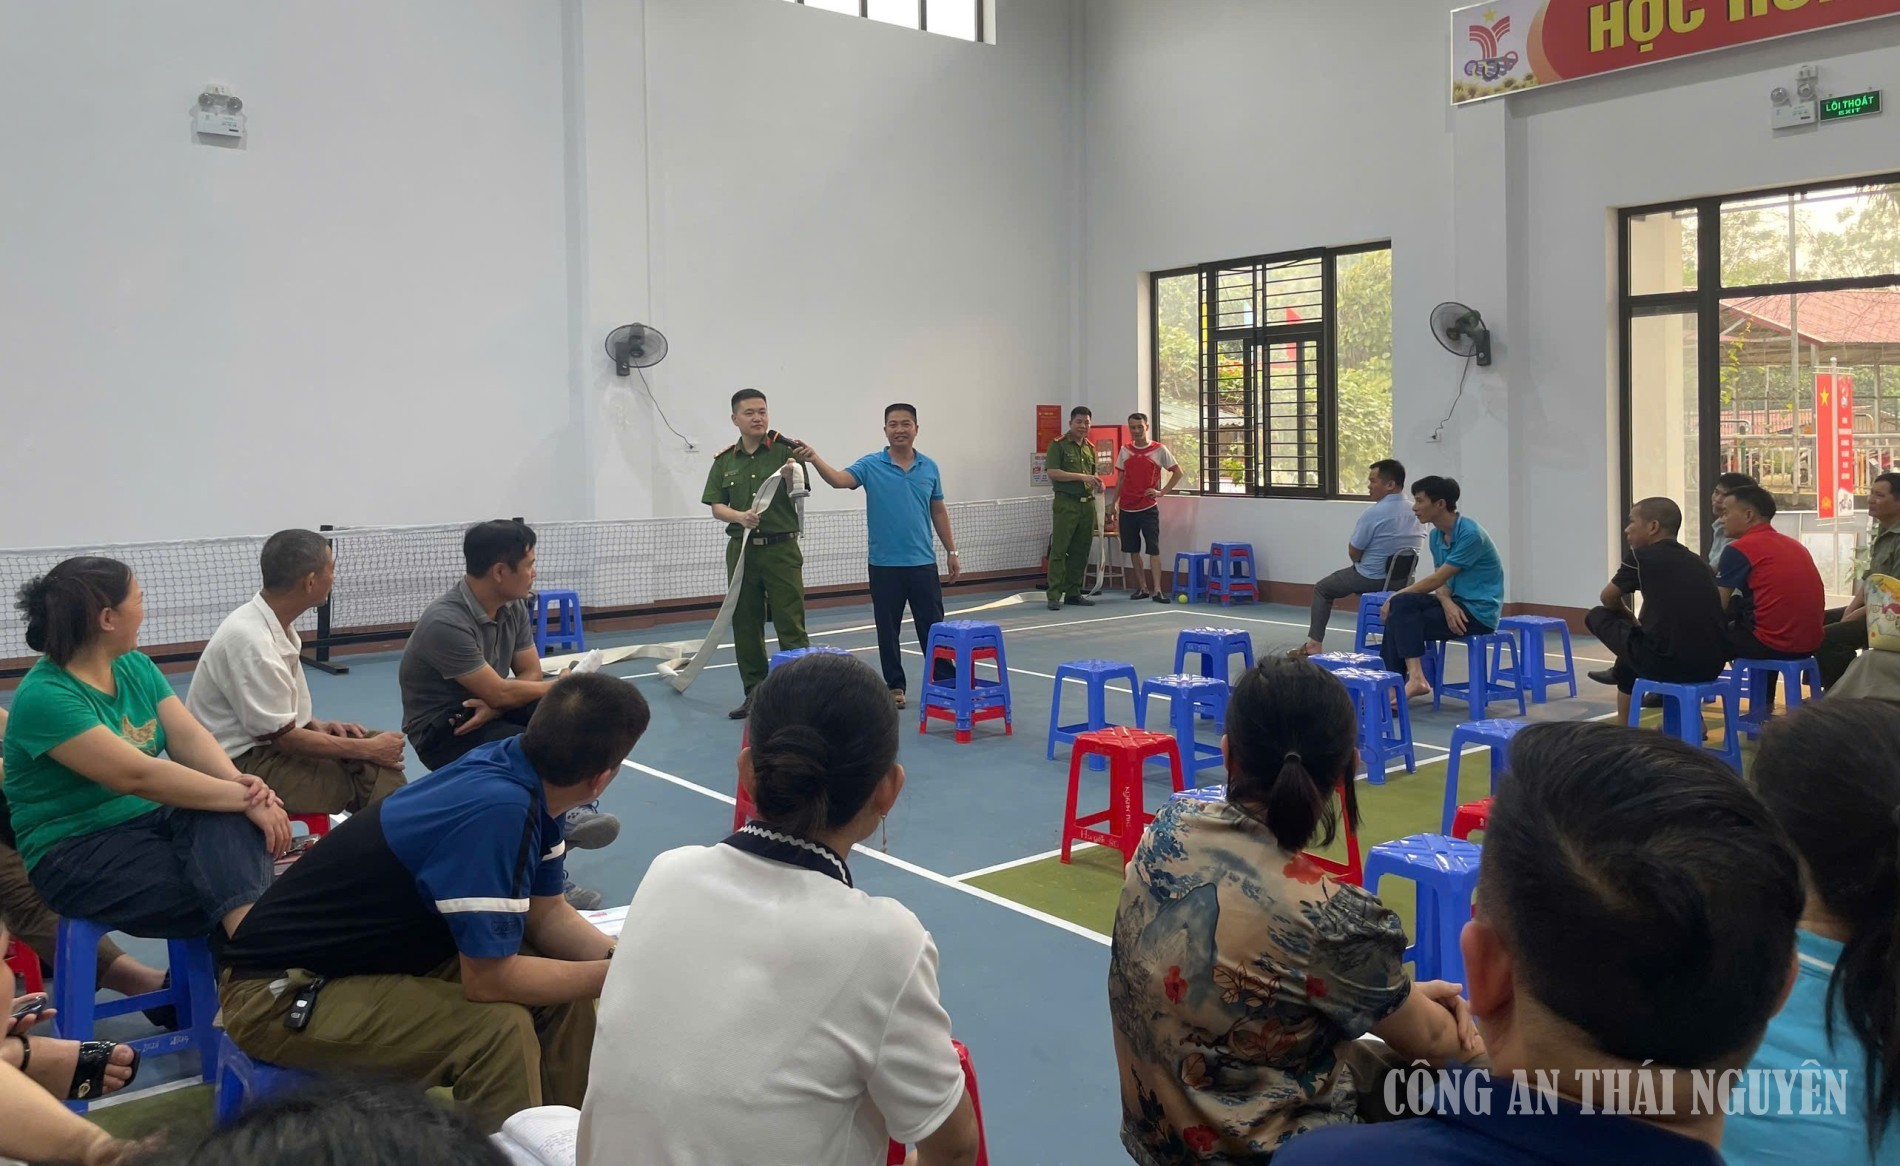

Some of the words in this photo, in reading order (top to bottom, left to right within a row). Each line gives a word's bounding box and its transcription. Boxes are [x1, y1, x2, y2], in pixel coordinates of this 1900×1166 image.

[1589, 0, 1705, 53] HỌC
[1842, 95, 1874, 109] THOÁT
[1838, 107, 1861, 116] EXIT
